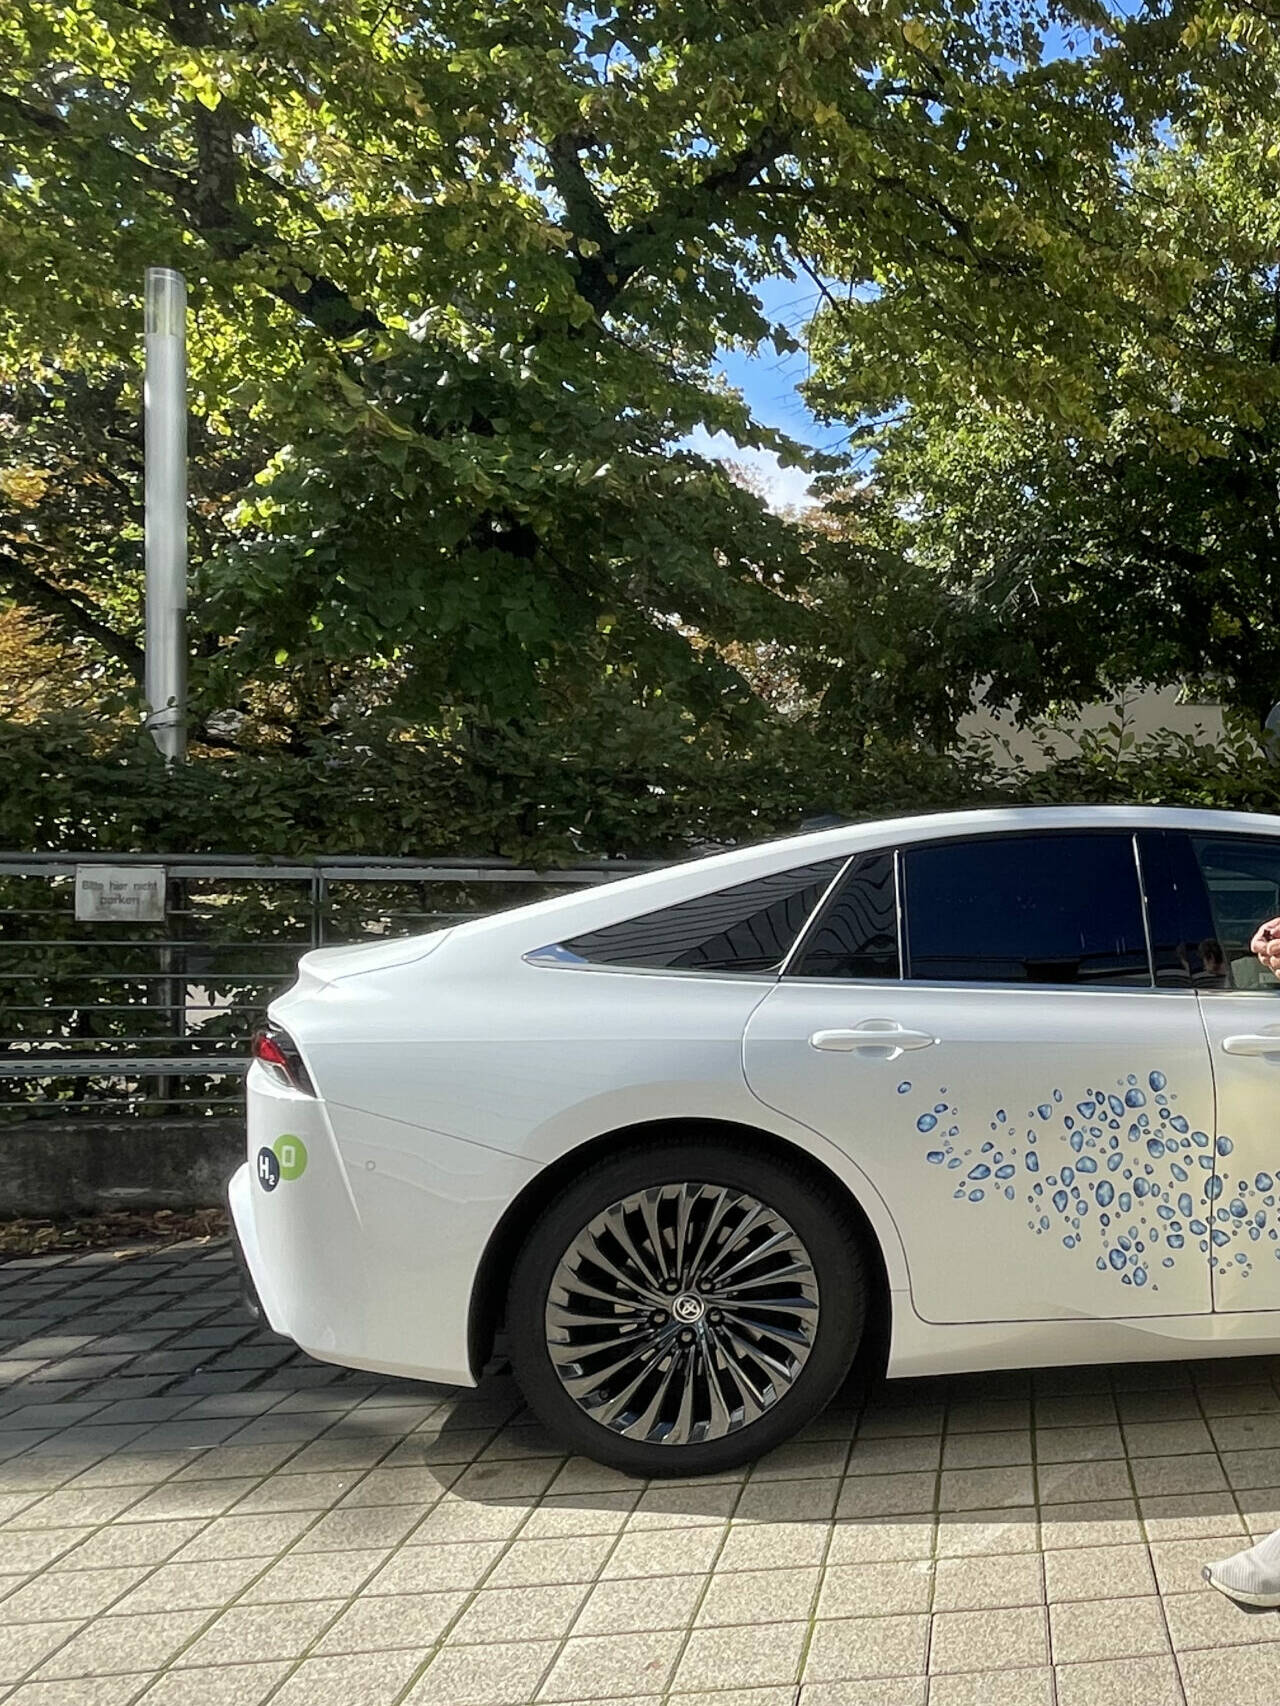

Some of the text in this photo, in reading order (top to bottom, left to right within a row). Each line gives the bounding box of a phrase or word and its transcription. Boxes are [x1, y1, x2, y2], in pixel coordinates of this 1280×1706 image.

[109, 880, 128, 890] hier
[133, 880, 157, 890] nicht
[100, 894, 140, 905] parken
